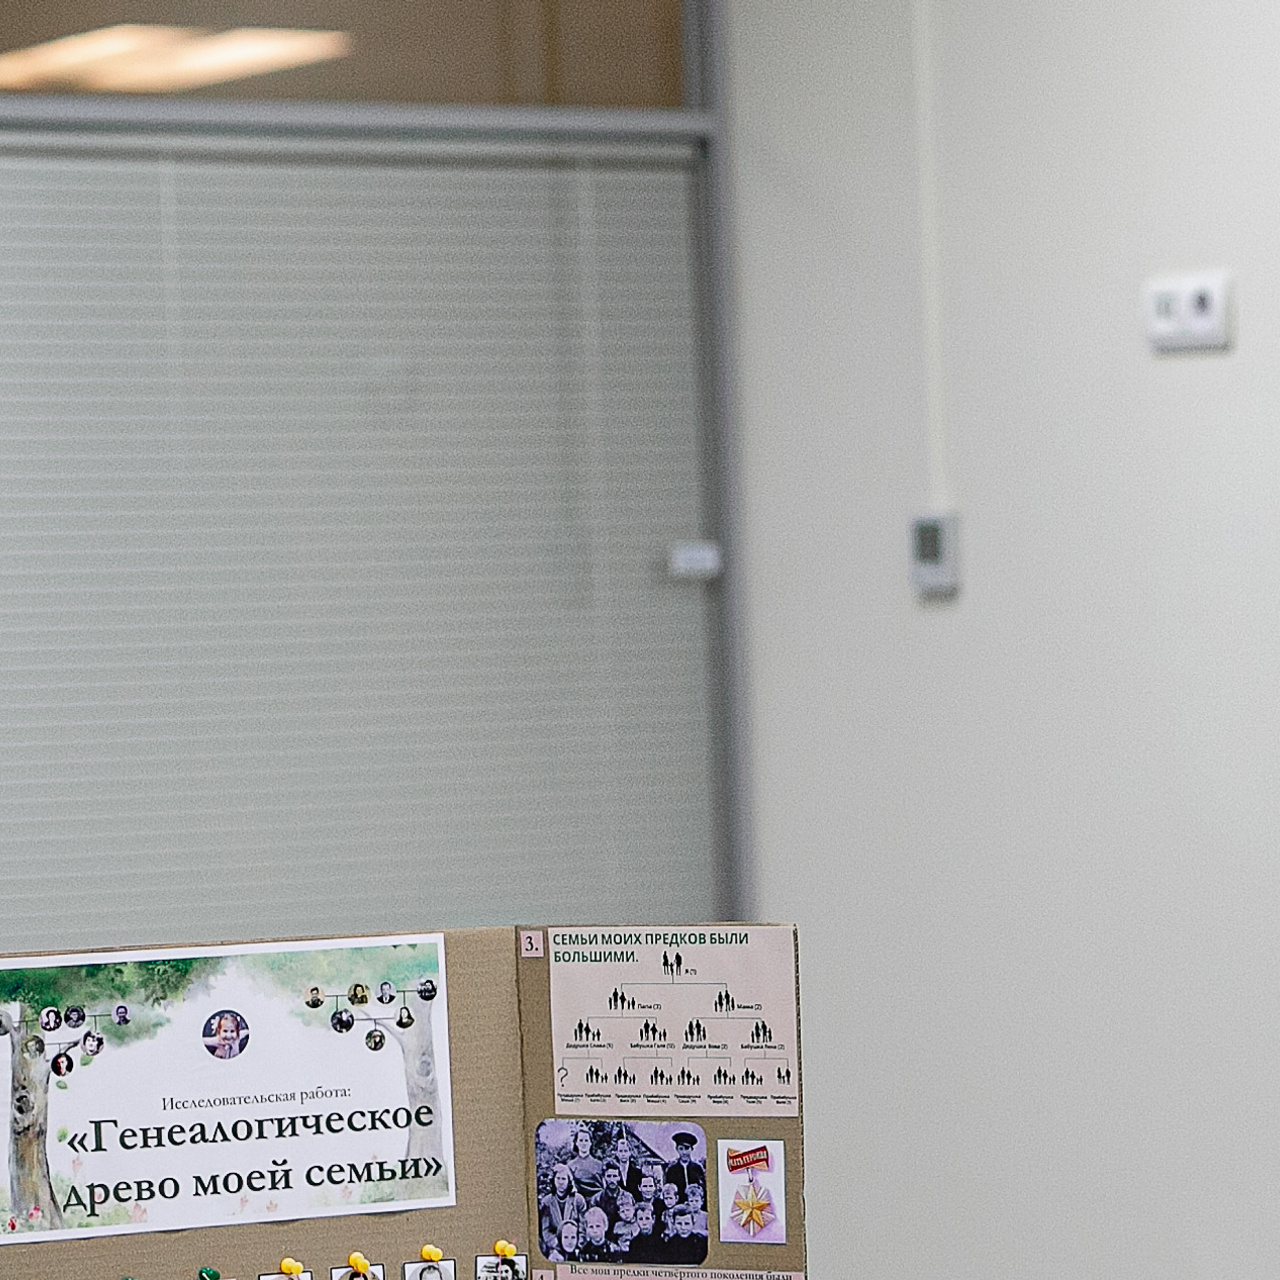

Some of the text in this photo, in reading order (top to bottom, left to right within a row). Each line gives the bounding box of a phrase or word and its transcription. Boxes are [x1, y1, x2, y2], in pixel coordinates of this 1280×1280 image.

[525, 936, 539, 952] 3.
[553, 933, 749, 947] СЕМЬИ МОИХ ПРЕДКОВ БЫЛИ
[554, 951, 639, 963] БОЛЬШИМИ.
[162, 1086, 352, 1111] Исследовательская работа:
[67, 1104, 434, 1153] «Генеалогическое
[63, 1154, 443, 1217] древо моей семьи»
[570, 1264, 588, 1275] Все
[613, 1268, 649, 1279] предки
[652, 1269, 708, 1280] четвёртого
[710, 1271, 764, 1280] поколения
[766, 1271, 792, 1280] были
